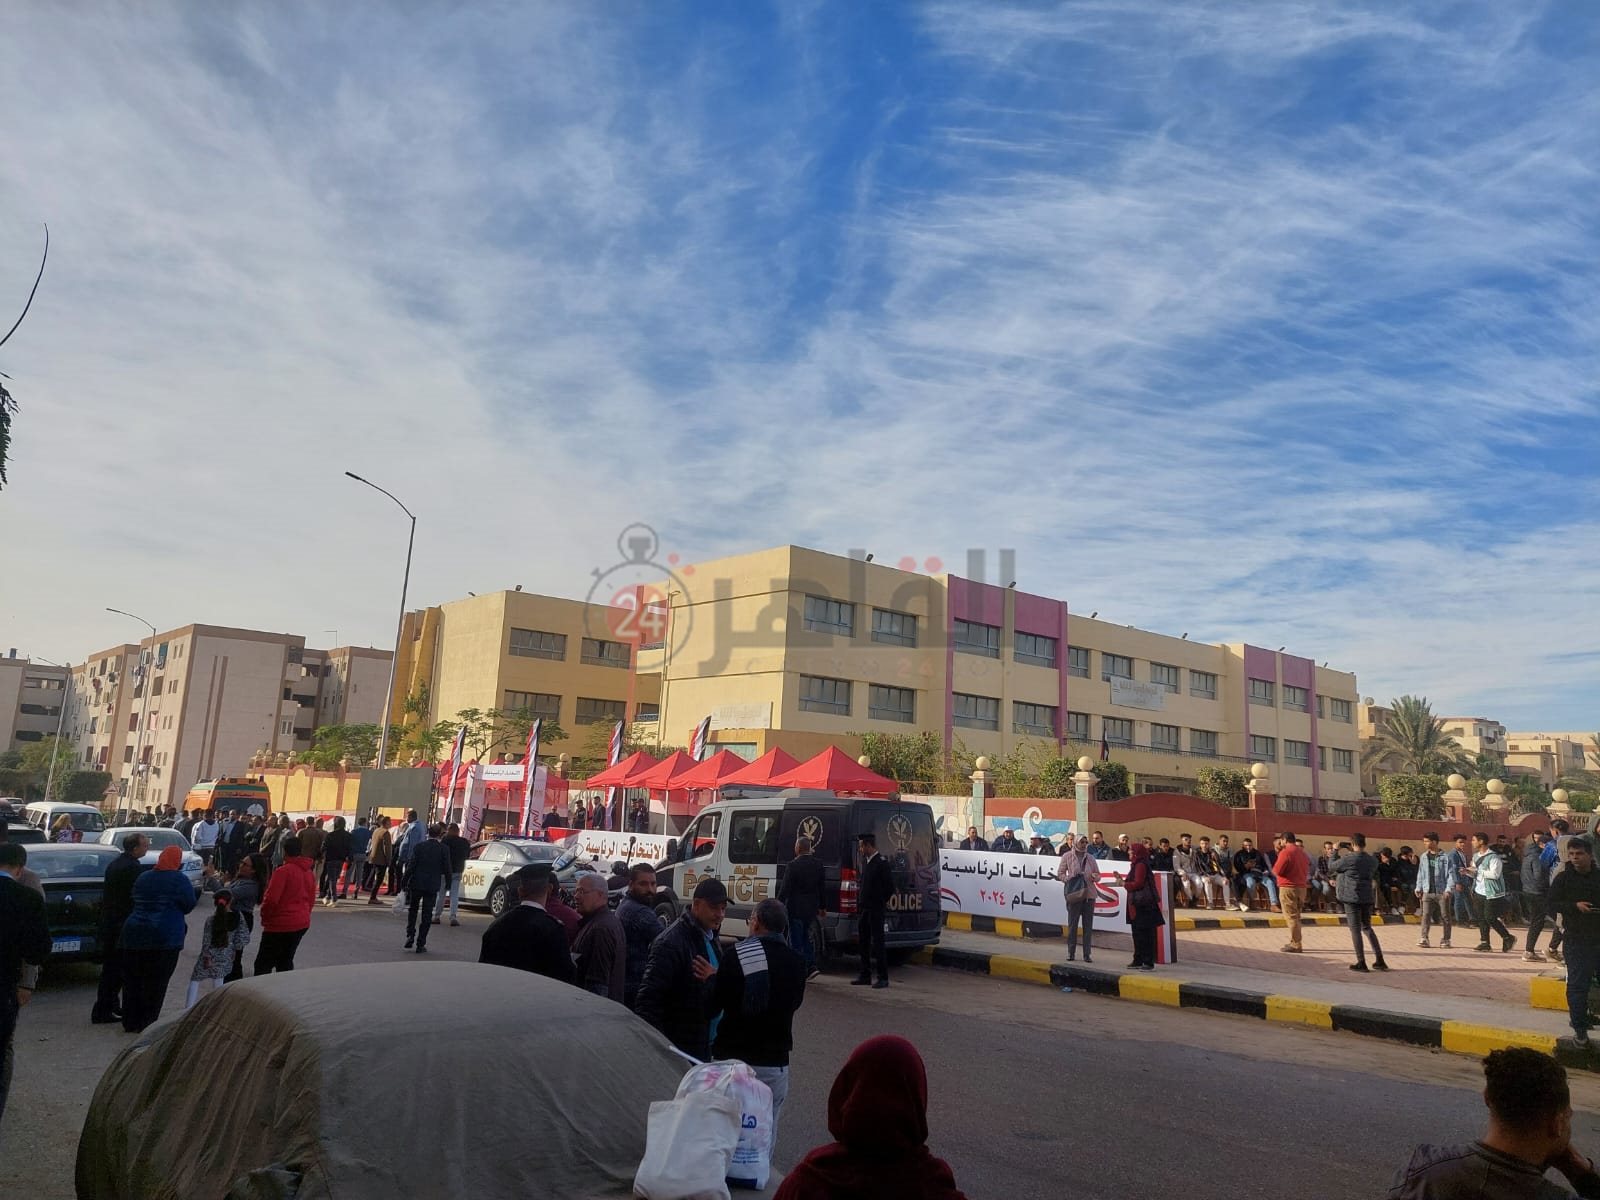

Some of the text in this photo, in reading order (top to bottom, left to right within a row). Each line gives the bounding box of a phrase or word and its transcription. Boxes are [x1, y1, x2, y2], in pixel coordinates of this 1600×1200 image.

[585, 837, 664, 862] الانتخابت الرئاسية
[462, 874, 485, 886] OLICE
[942, 856, 1062, 885] خابات الرئاسية
[682, 873, 770, 902] PICE
[979, 889, 1043, 912] عام ٢٠٢٤
